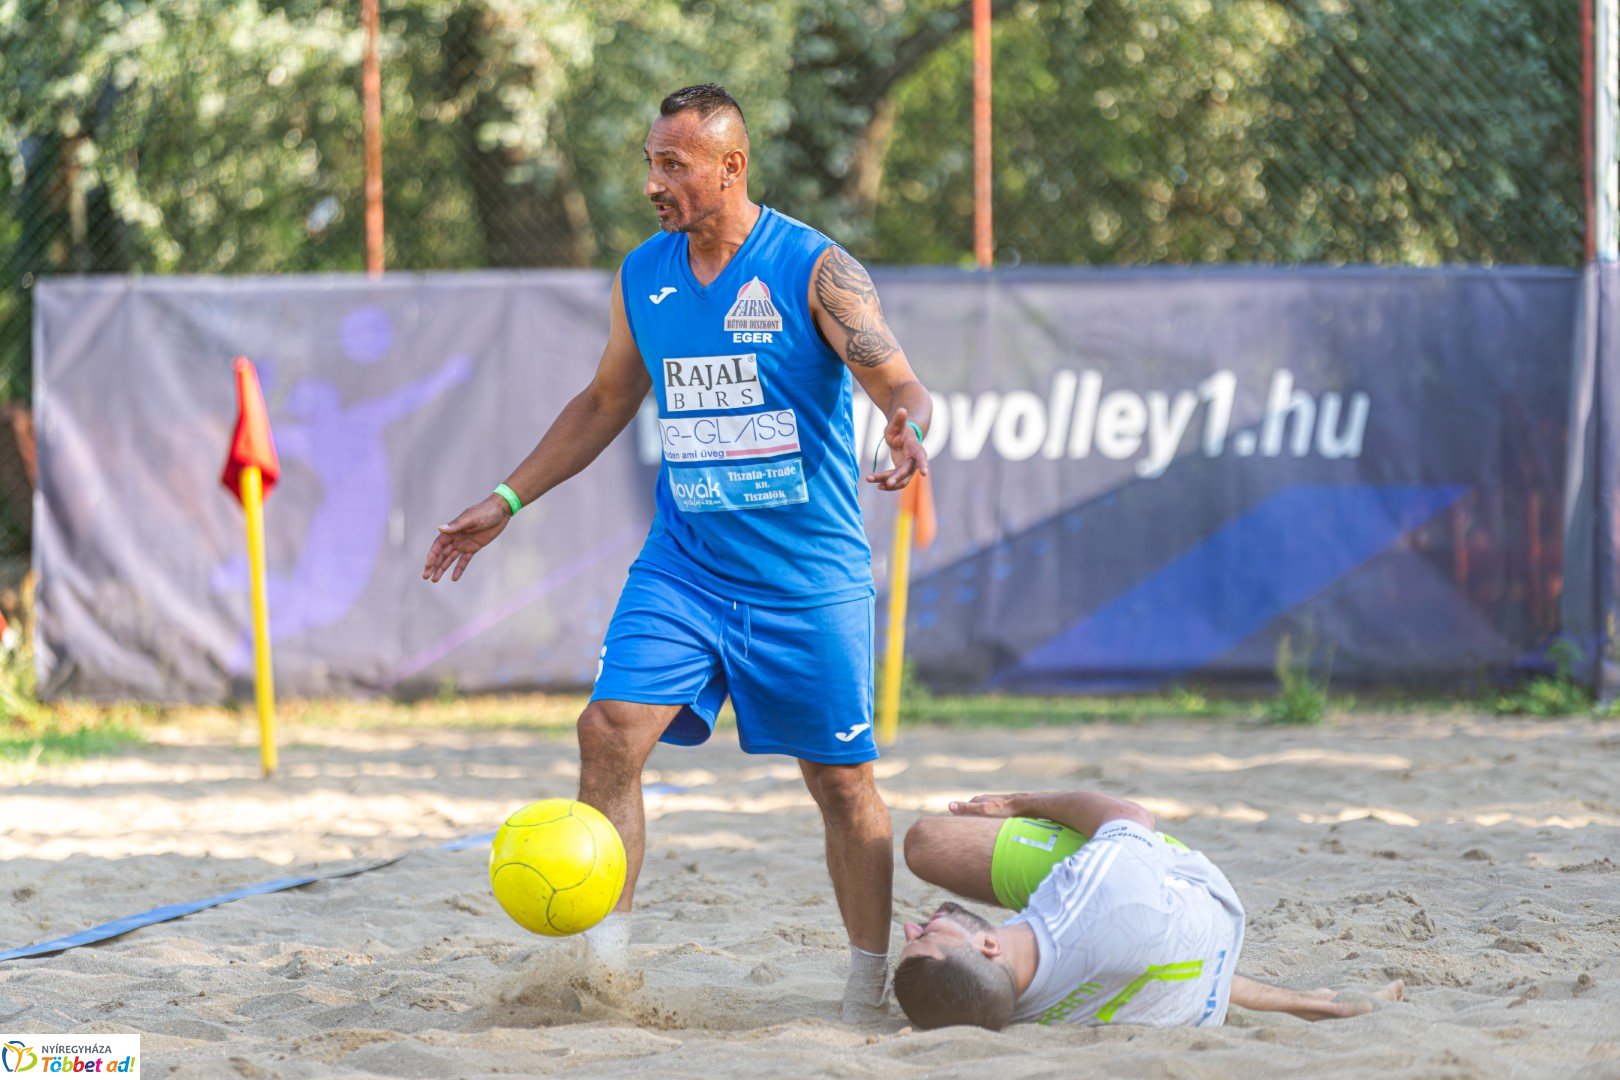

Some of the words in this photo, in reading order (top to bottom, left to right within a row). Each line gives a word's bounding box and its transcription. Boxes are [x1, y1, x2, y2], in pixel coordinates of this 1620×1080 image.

[750, 320, 780, 329] DISZKONT
[733, 332, 773, 343] EGER
[665, 357, 757, 391] RAJAL
[682, 450, 698, 459] ami
[700, 449, 725, 459] üveg
